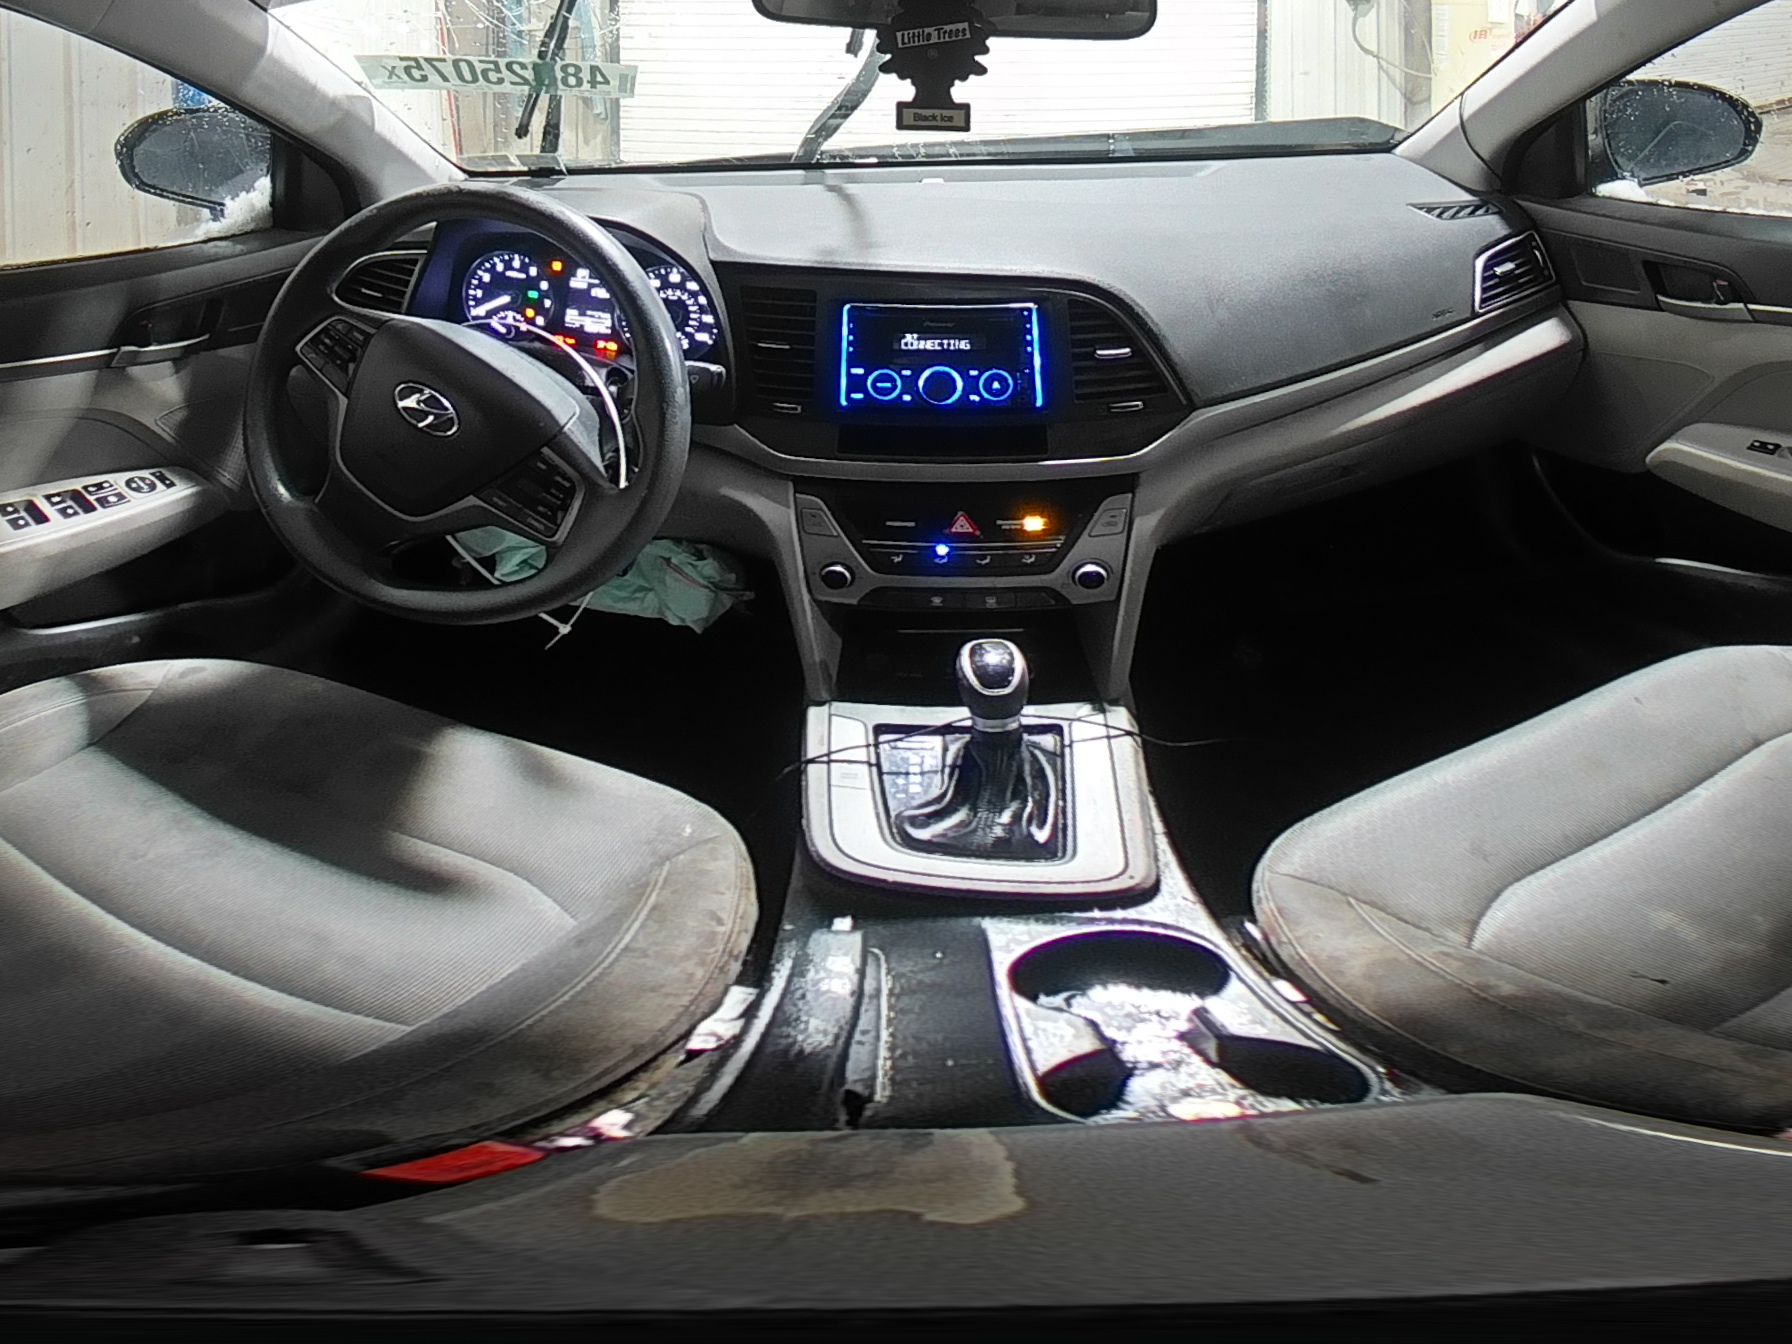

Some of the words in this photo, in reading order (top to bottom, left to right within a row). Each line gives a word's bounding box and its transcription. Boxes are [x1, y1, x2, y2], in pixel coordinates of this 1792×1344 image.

[901, 29, 933, 46] Little
[934, 27, 968, 41] Trees
[913, 112, 939, 122] Black
[940, 112, 954, 123] Ice
[900, 339, 972, 350] CONNECTING
